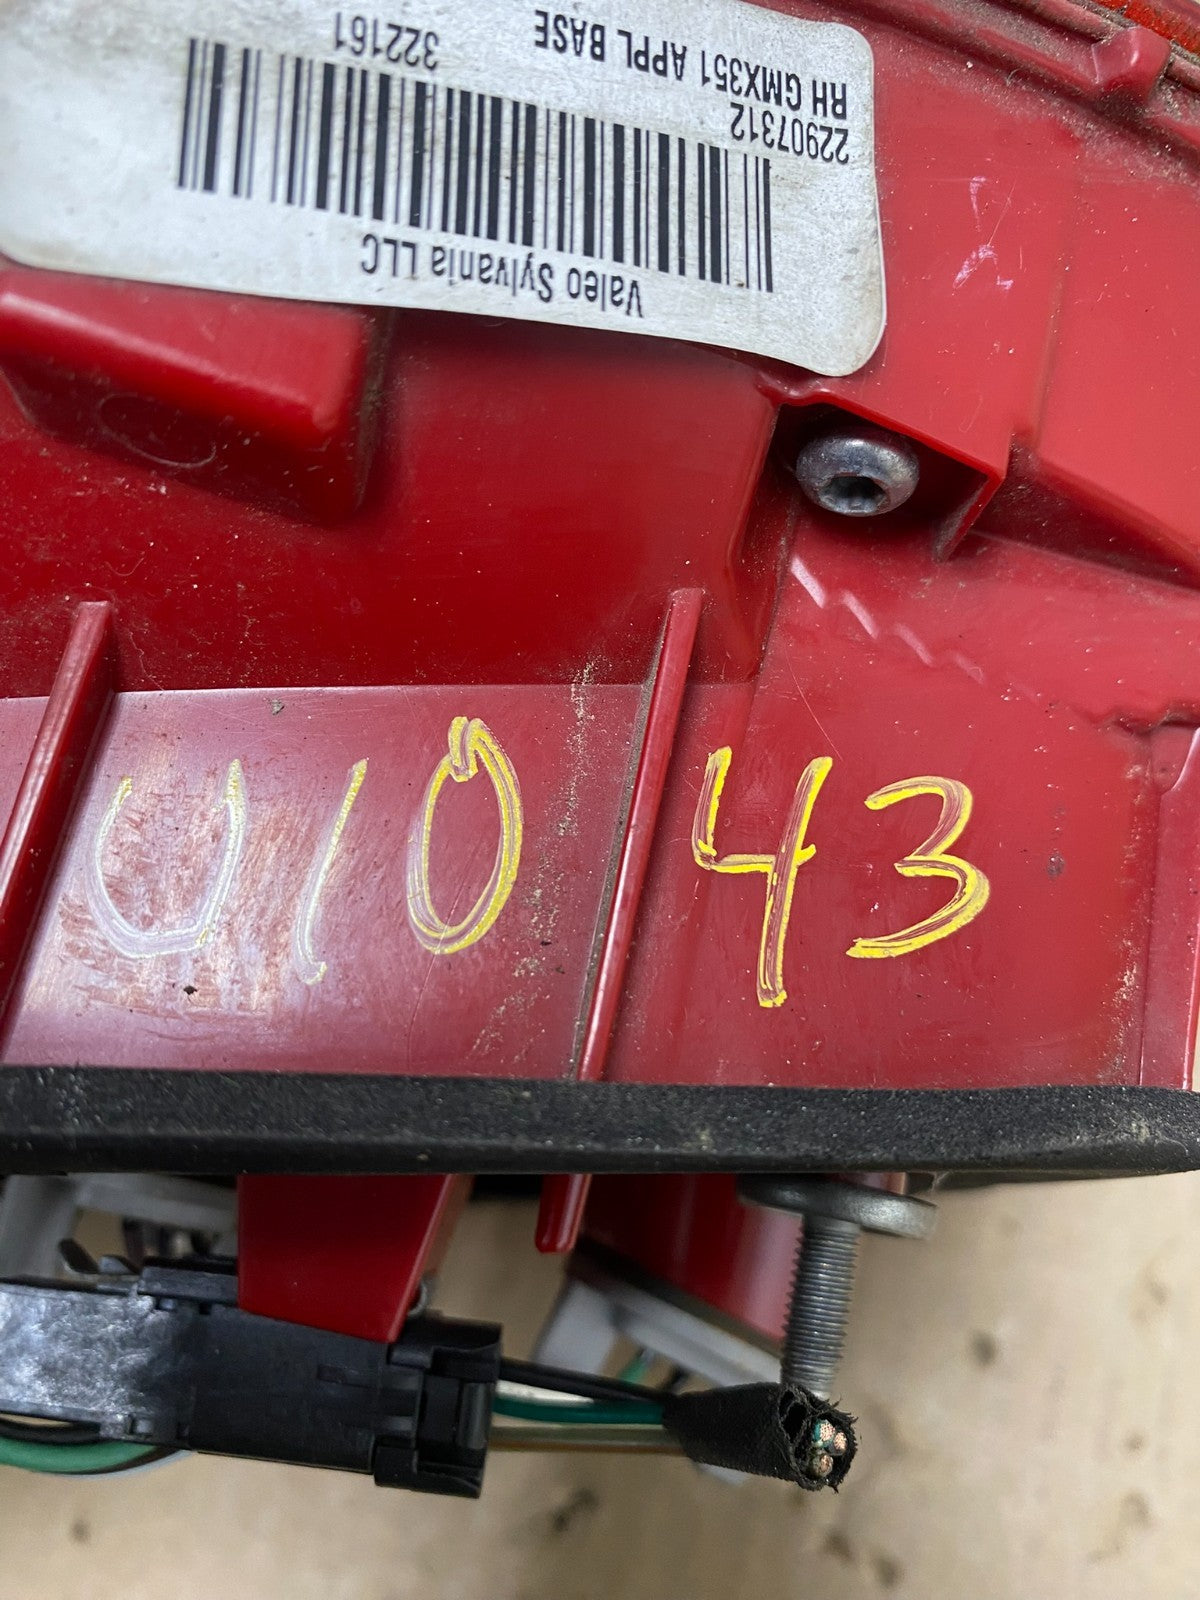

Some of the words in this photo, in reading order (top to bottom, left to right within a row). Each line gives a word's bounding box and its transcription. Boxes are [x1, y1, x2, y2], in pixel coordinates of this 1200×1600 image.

[334, 11, 440, 72] 322161
[534, 9, 606, 63] BASE
[616, 28, 688, 82] APPL
[700, 49, 801, 112] GMX351
[811, 79, 847, 120] RH
[729, 101, 849, 165] 22907312
[360, 233, 418, 278] LLC
[431, 245, 554, 303] Sylvania
[567, 266, 644, 318] Valeo
